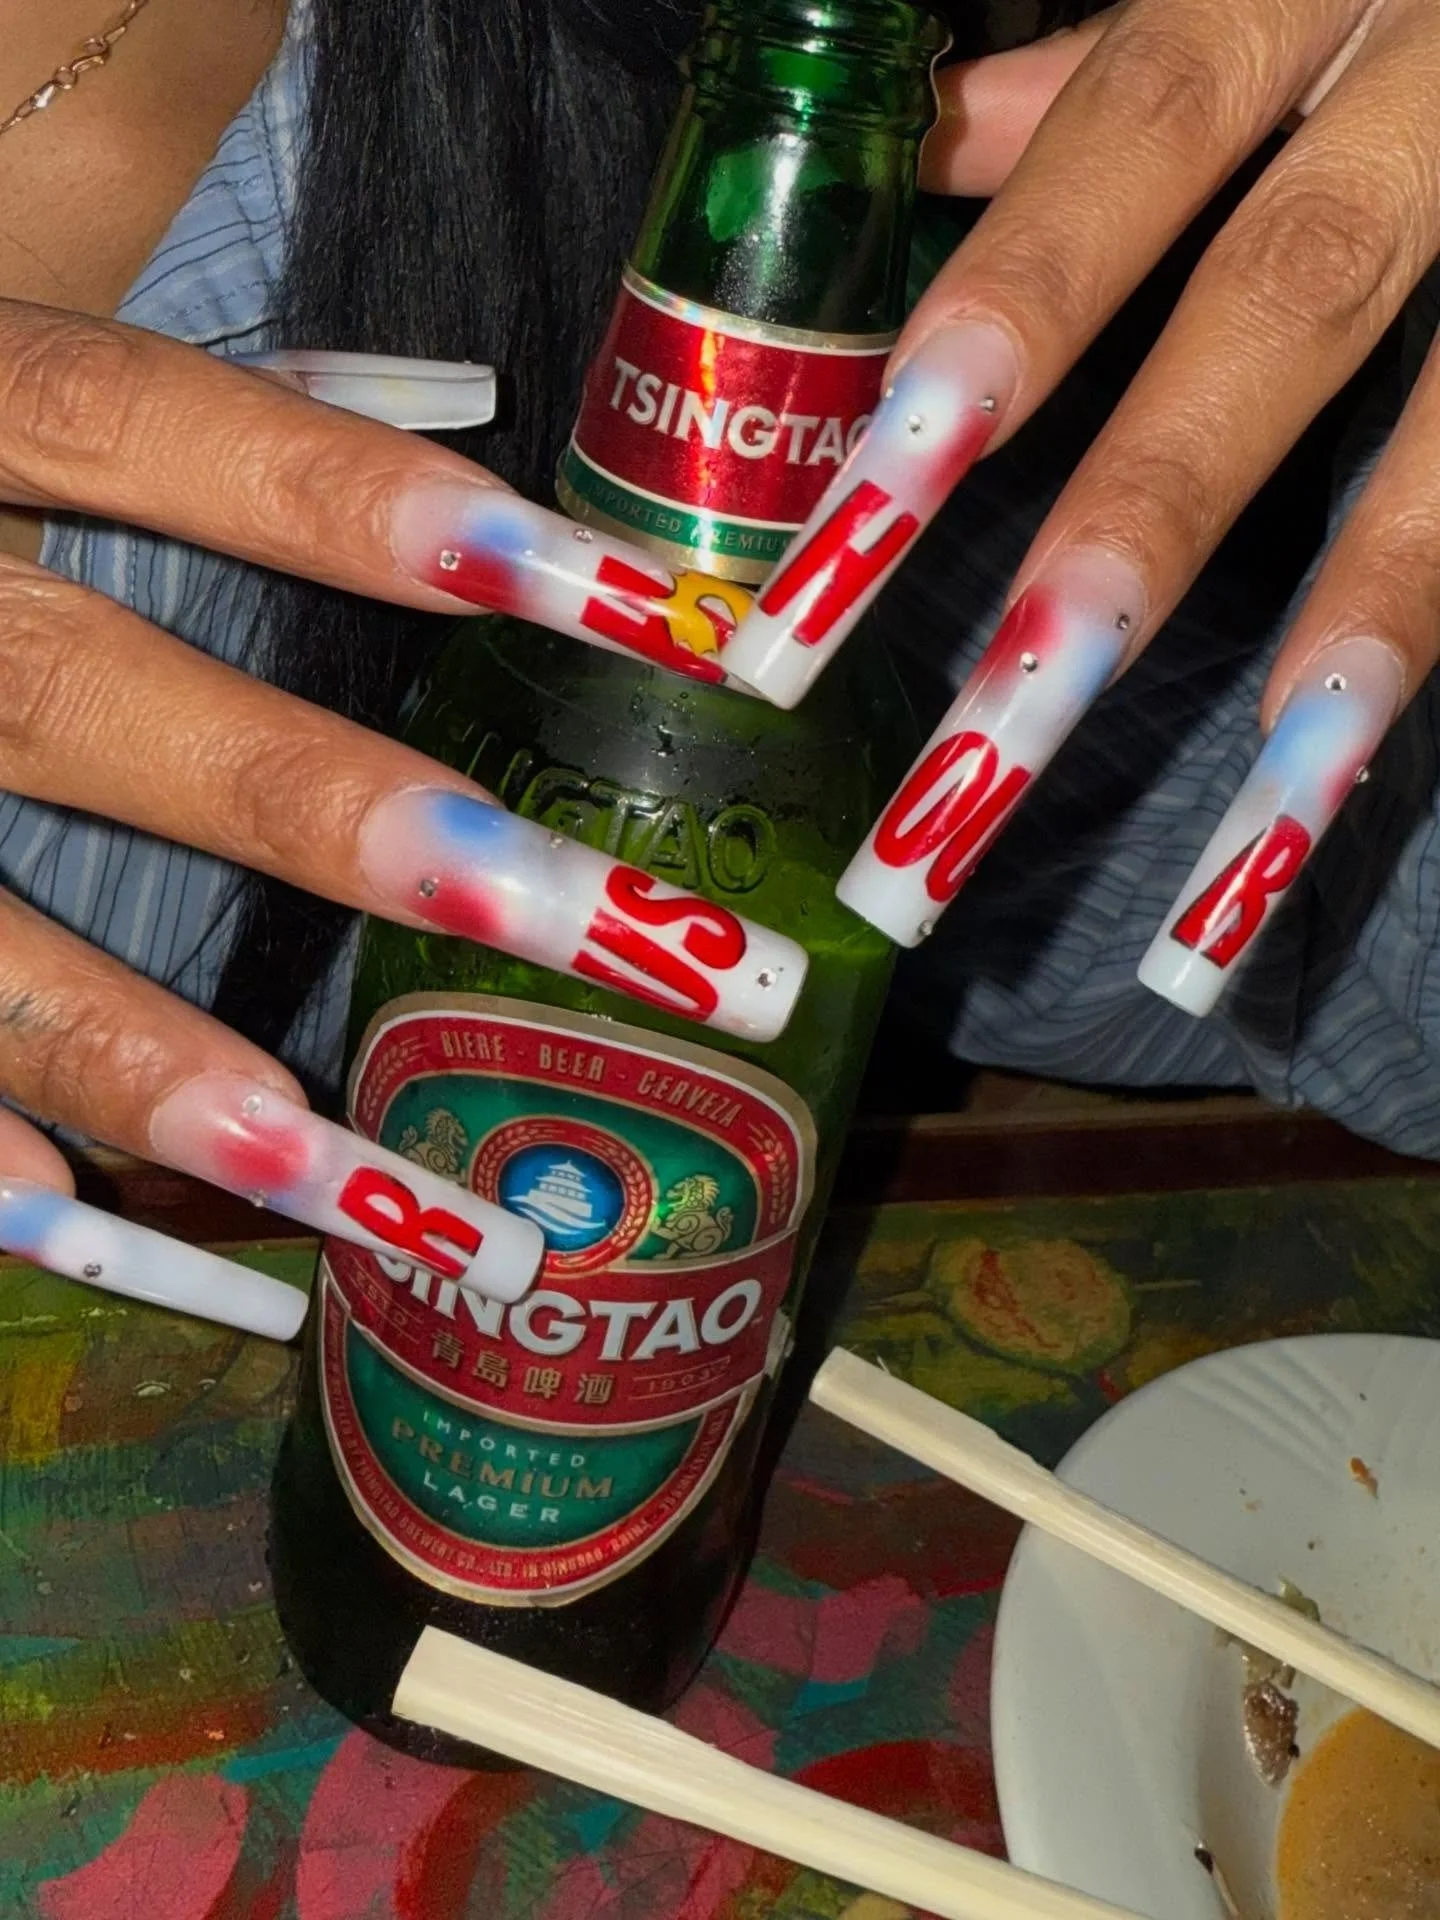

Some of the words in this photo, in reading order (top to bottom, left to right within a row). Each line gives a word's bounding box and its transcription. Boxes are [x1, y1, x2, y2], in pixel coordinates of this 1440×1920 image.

[440, 1030, 506, 1063] BIERE
[538, 1043, 605, 1083] BEER
[637, 1070, 744, 1129] CERVEZA
[432, 1330, 615, 1404] 青島啤酒
[392, 1417, 614, 1498] PREMIUM
[423, 1411, 585, 1468] IMPORTED
[423, 1471, 561, 1524] LAGER
